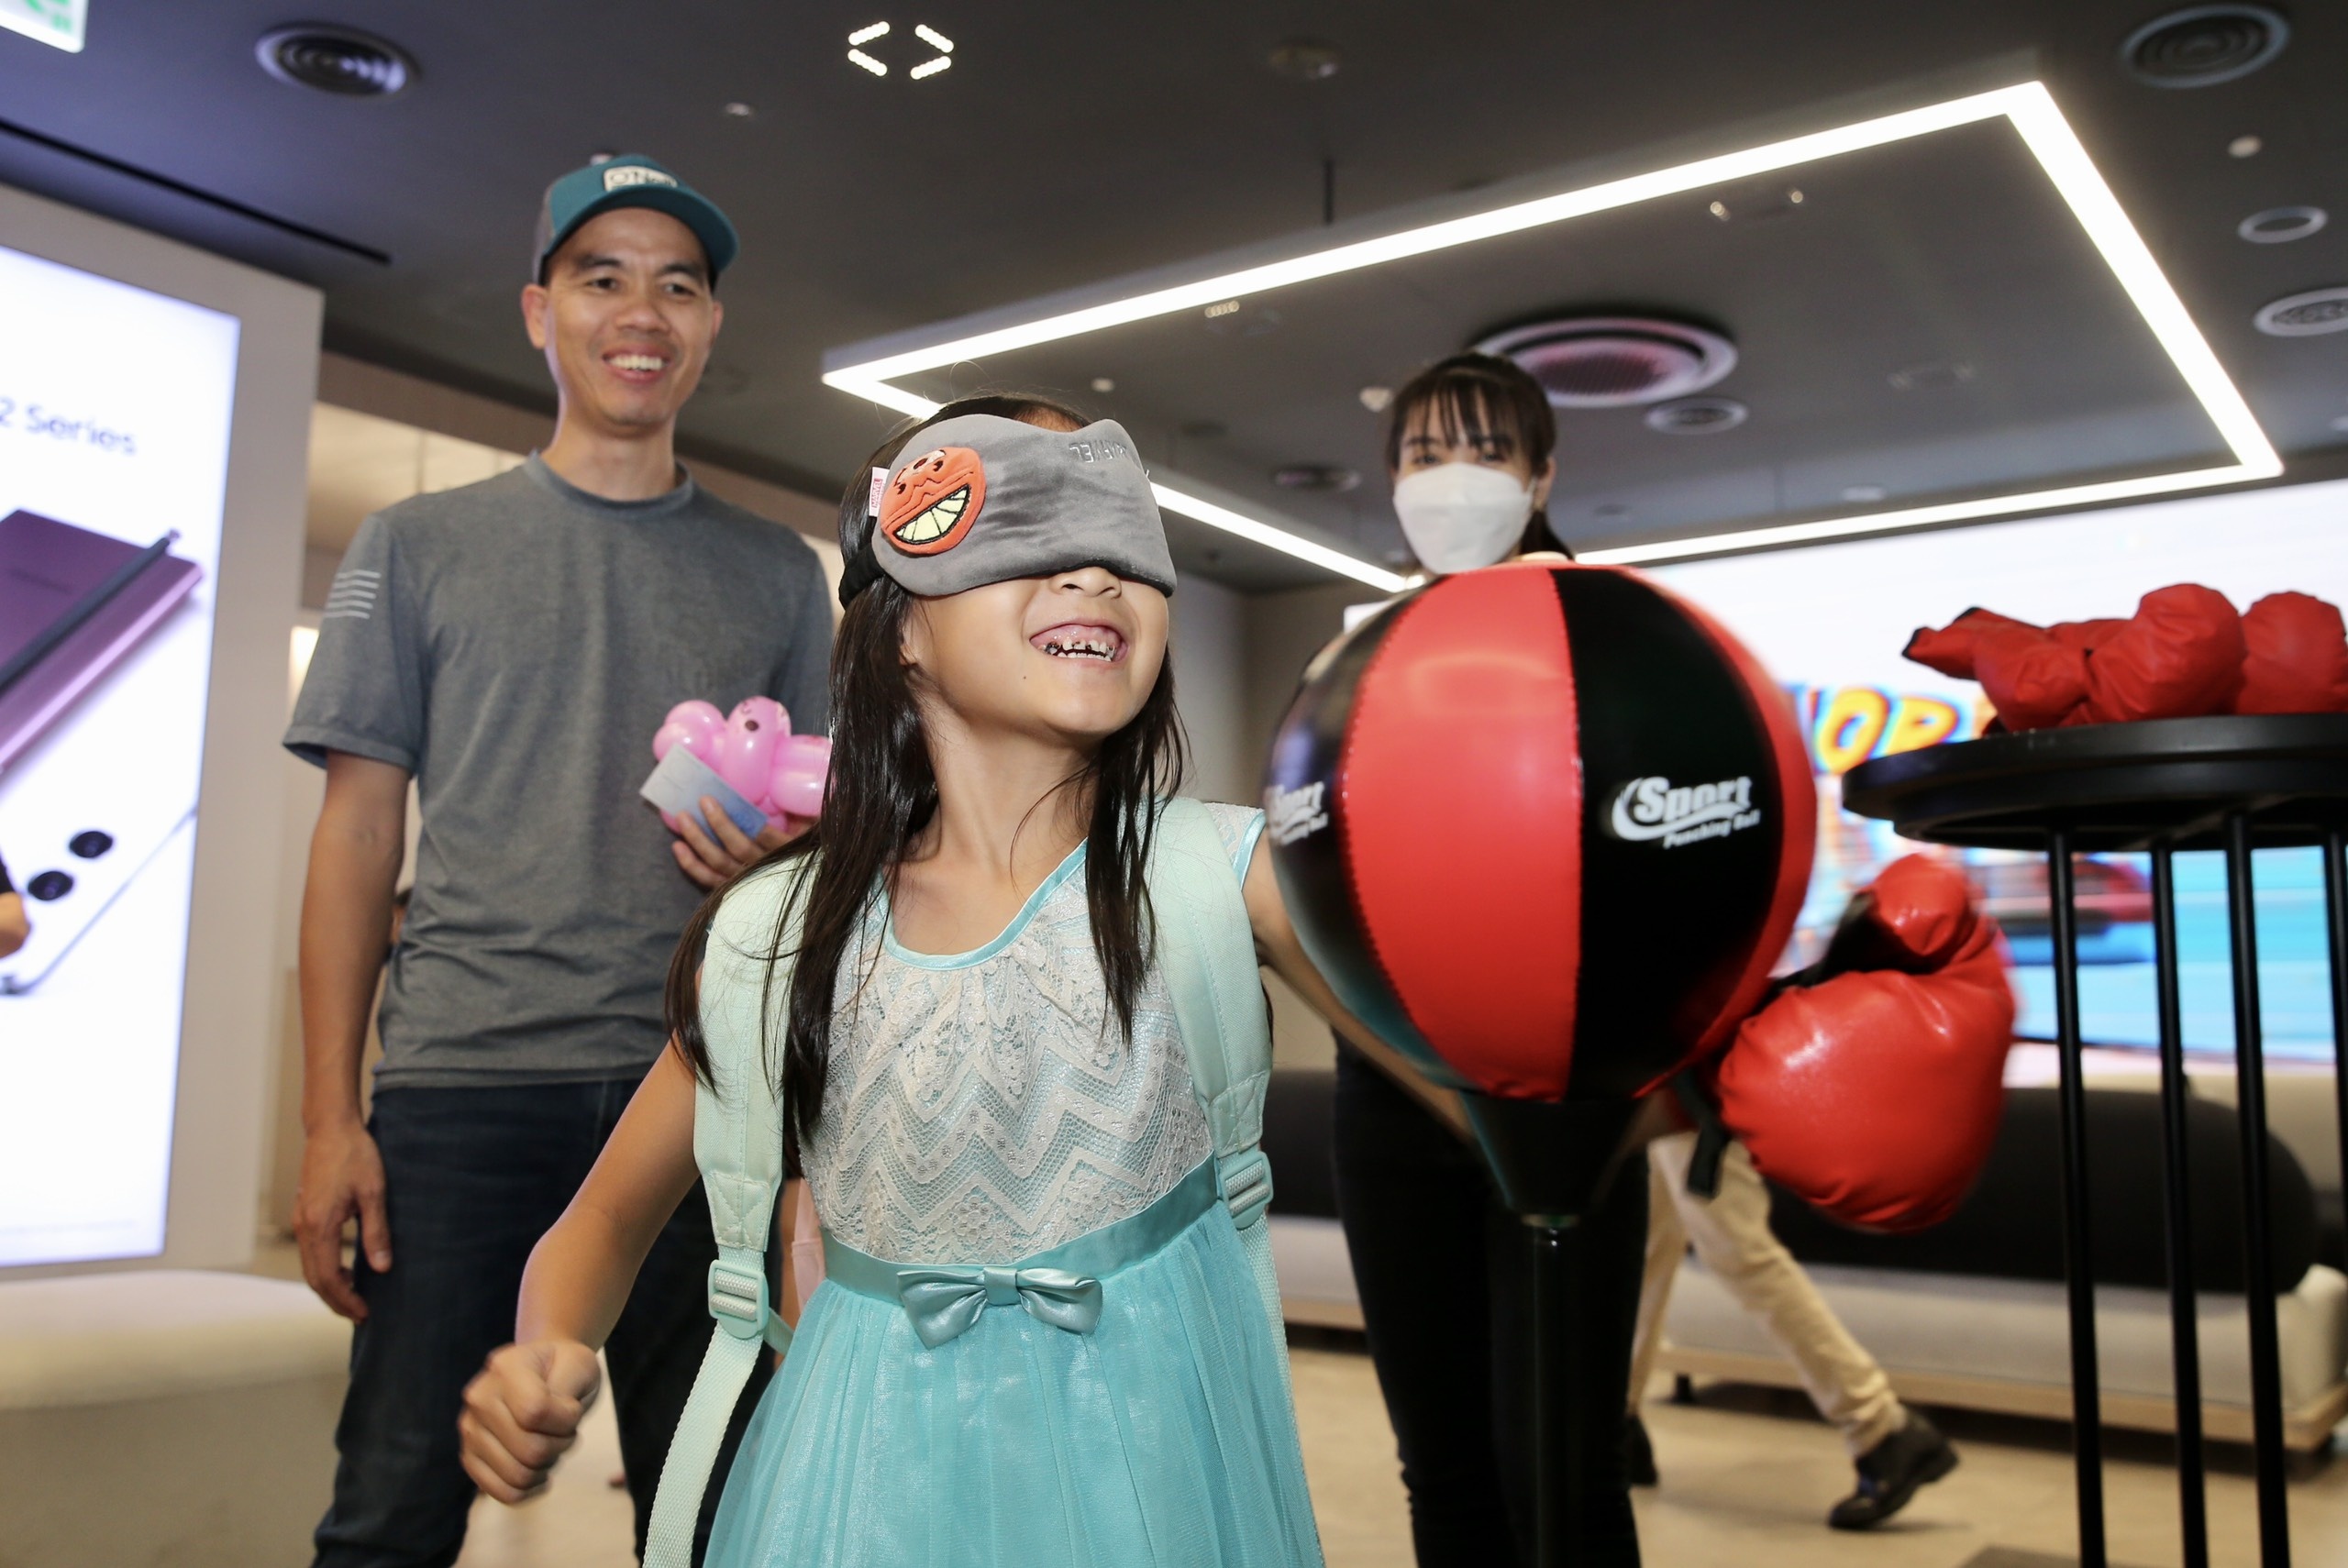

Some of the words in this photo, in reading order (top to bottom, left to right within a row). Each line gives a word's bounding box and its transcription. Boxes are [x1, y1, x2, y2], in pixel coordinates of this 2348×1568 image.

[25, 403, 136, 456] Series
[871, 478, 883, 509] MARVEL
[1809, 685, 1959, 774] OP
[1633, 776, 1752, 824] Sport
